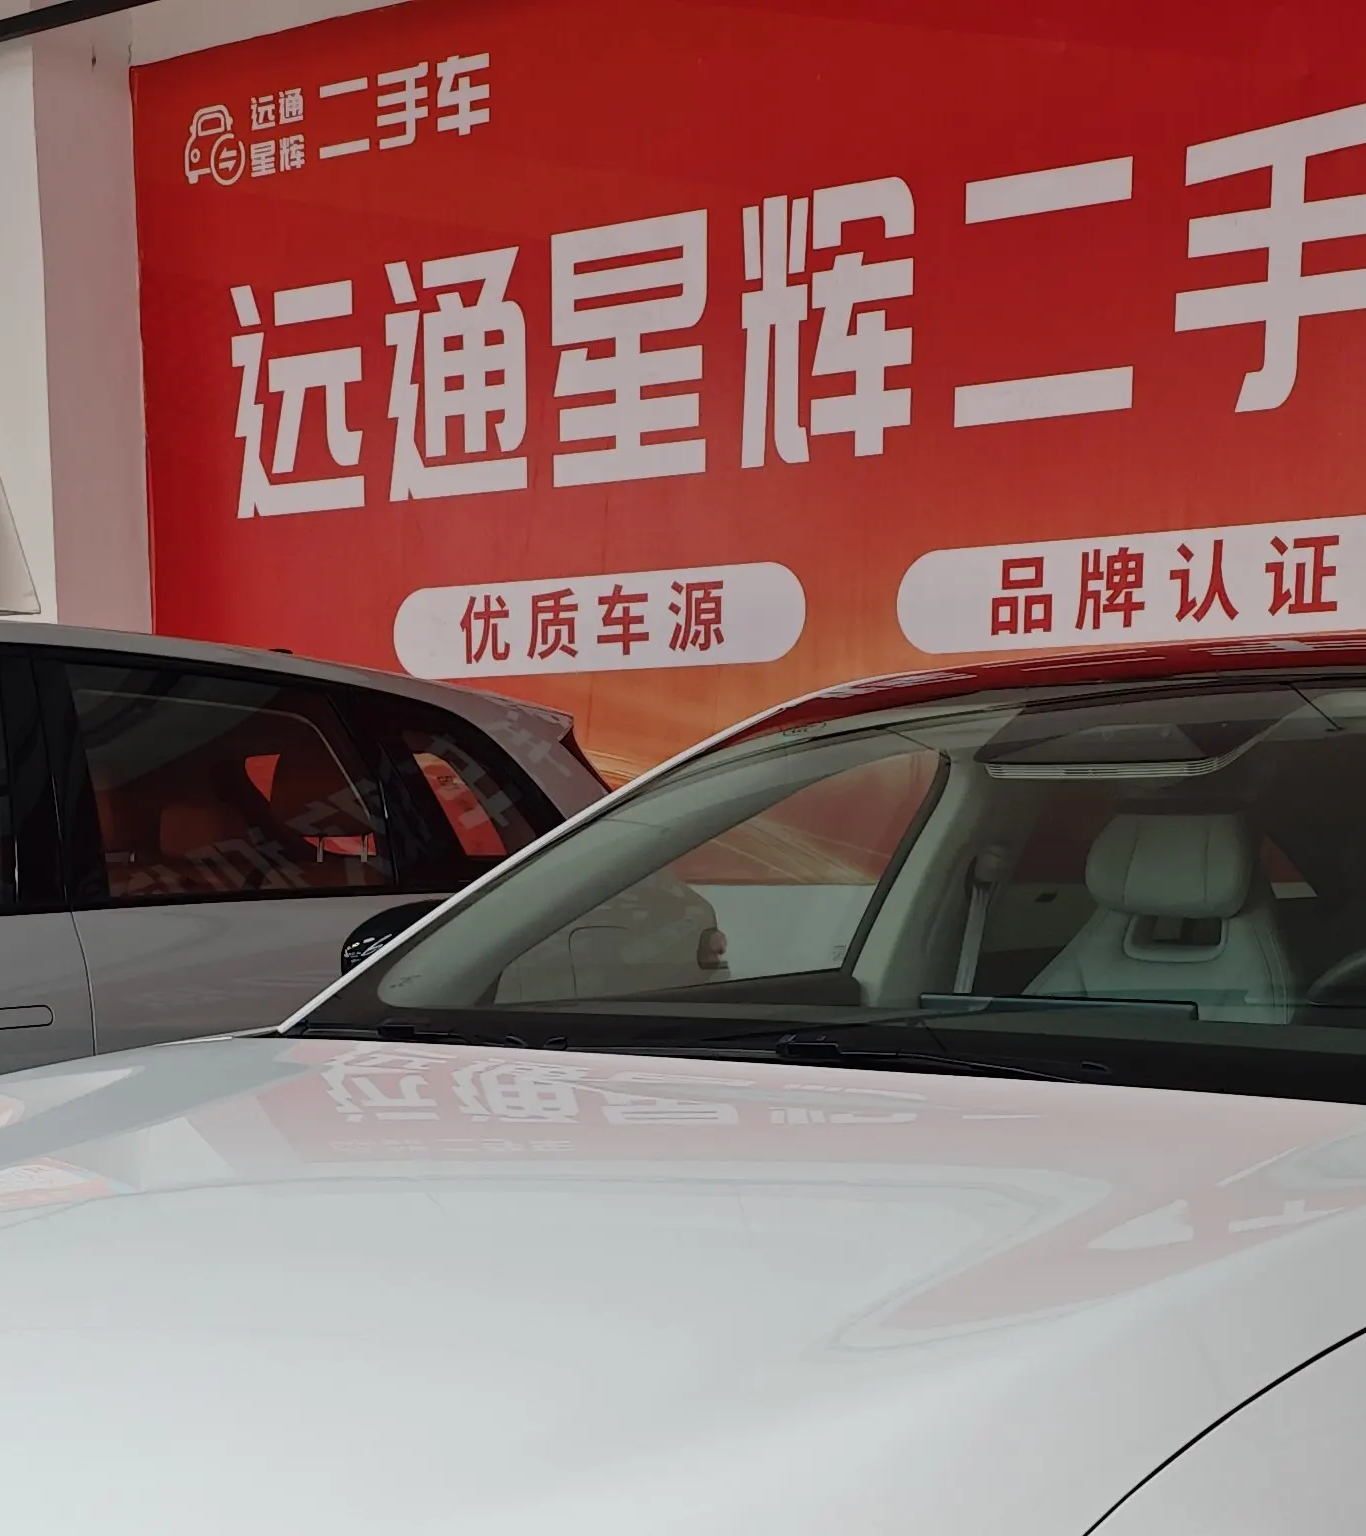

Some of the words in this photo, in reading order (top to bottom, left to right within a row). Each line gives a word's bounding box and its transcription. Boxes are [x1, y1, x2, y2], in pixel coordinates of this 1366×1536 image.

[250, 88, 304, 131] 远通
[319, 53, 491, 159] 二手车
[250, 134, 305, 178] 星辉
[459, 580, 726, 663] 优质车源
[990, 534, 1340, 637] 品牌认证
